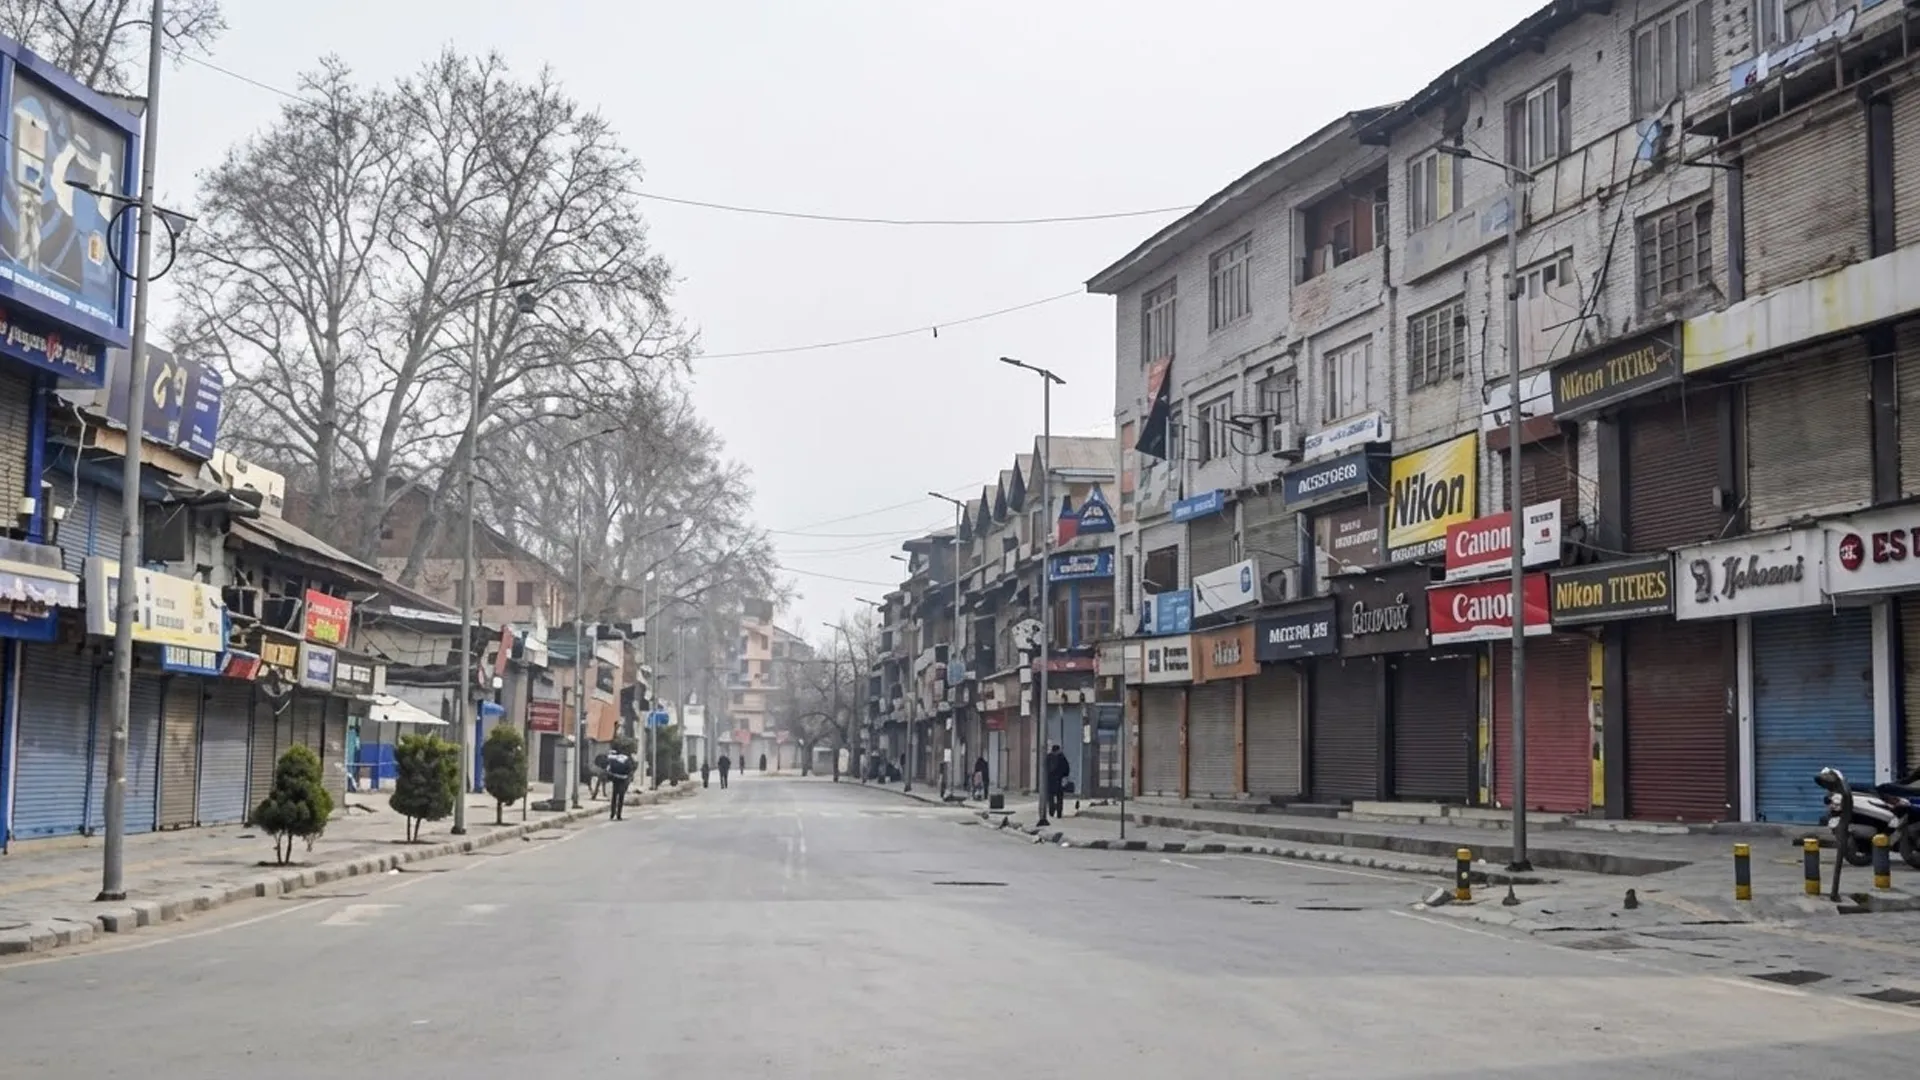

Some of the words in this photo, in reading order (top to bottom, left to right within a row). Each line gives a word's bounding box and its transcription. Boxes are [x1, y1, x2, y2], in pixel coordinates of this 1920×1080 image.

[1391, 471, 1465, 530] Nikon
[1455, 525, 1511, 558] Canon
[1556, 581, 1603, 610] Nikon
